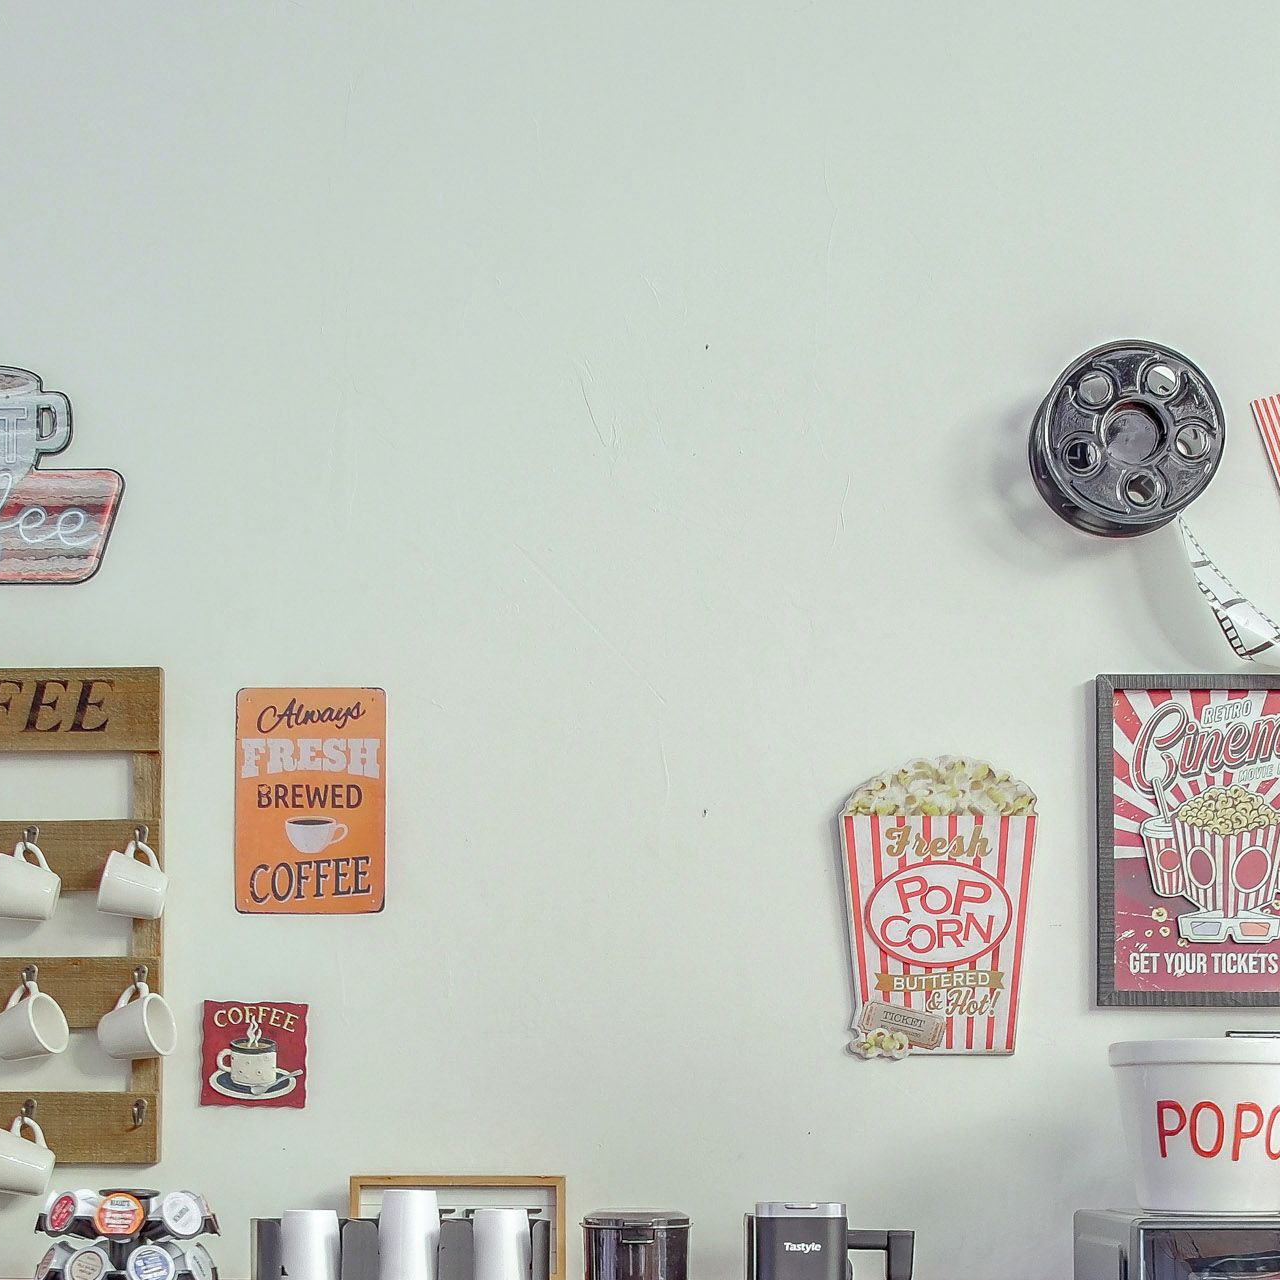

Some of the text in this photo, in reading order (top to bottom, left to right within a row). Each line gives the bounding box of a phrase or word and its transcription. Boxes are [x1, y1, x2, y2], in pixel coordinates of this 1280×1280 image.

[257, 698, 366, 734] Always
[1203, 699, 1252, 723] RETRO
[241, 738, 380, 779] FRESH
[1237, 765, 1274, 784] MOVIE
[257, 784, 363, 809] BREWED
[885, 825, 992, 857] Fresh
[249, 855, 373, 904] COFFEE
[894, 876, 992, 915] POP
[880, 912, 994, 954] CORN
[1129, 952, 1278, 975] GET YOUR TICKETS
[894, 970, 989, 991] BUTTERED
[926, 988, 999, 1016] & Hot!
[214, 1006, 299, 1032] COFFEE
[883, 1010, 926, 1028] TICKET
